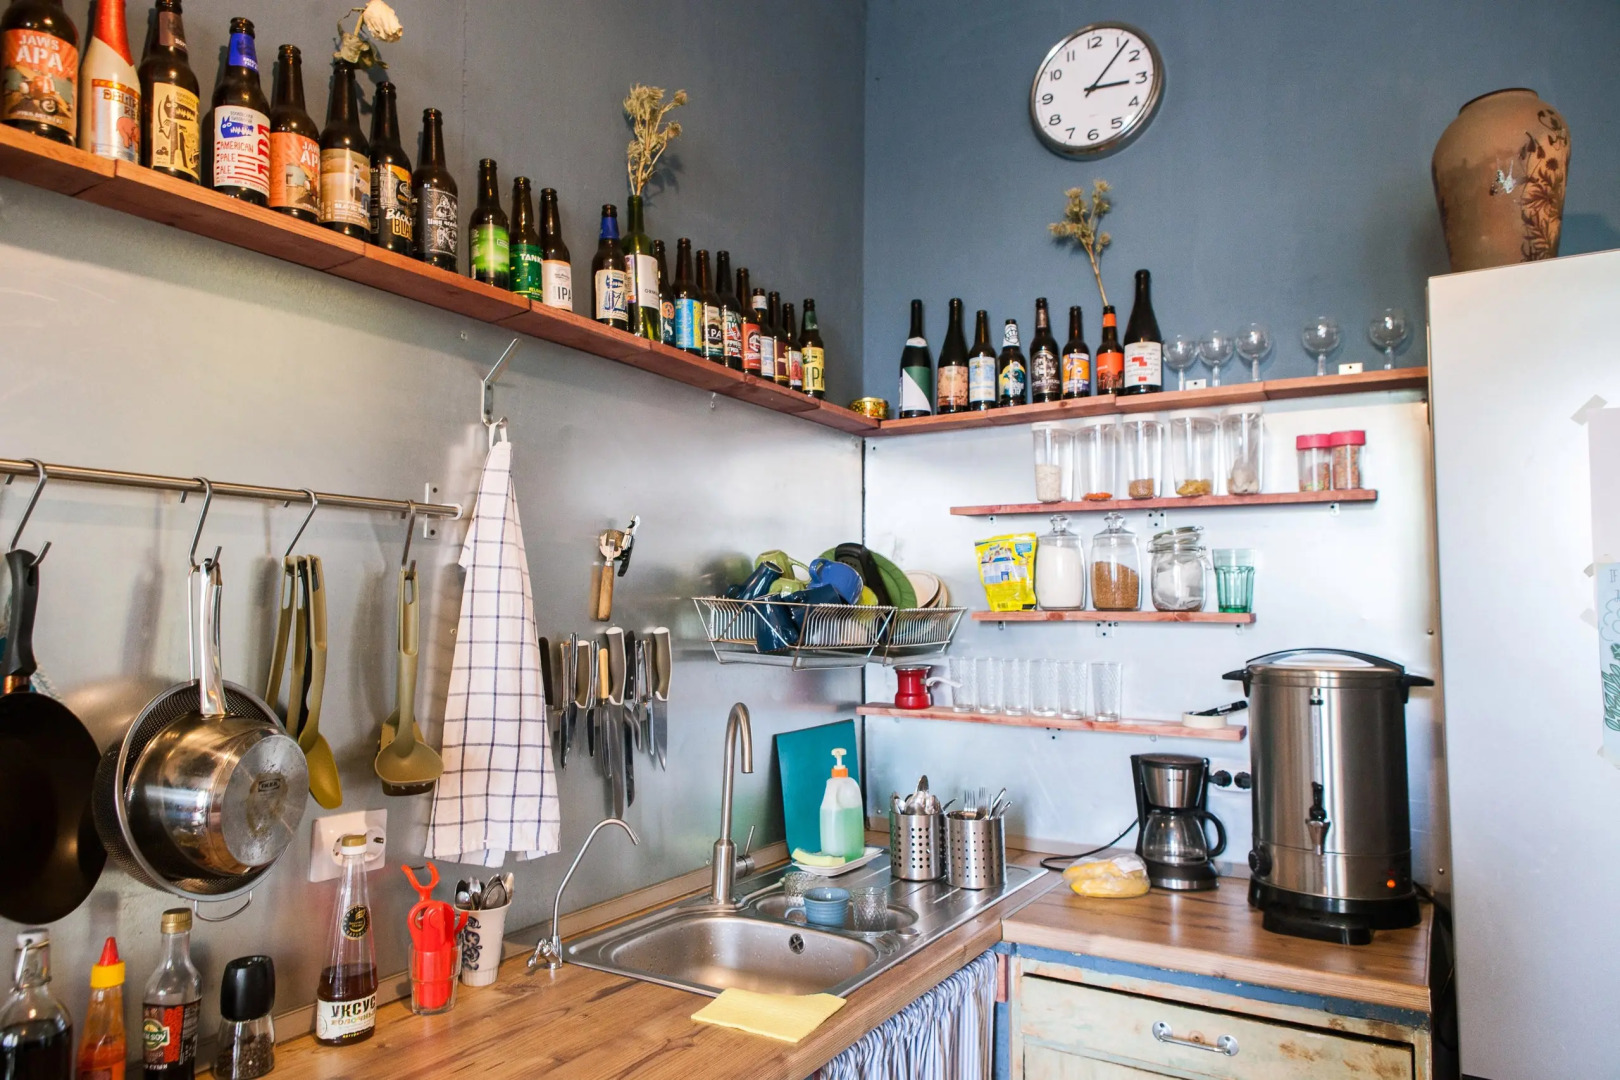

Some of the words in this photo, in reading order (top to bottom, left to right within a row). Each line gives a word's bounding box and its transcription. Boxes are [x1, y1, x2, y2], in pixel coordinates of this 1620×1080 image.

[19, 34, 60, 51] JAWS
[1087, 36, 1102, 49] 12
[15, 45, 63, 72] APA
[1066, 50, 1075, 62] 11
[1128, 50, 1140, 62] 2
[1050, 69, 1062, 81] 10
[1135, 71, 1148, 84] 3
[1042, 93, 1054, 105] 9
[1128, 95, 1139, 107] 4
[1049, 114, 1061, 126] 8
[1111, 117, 1123, 129] 5
[1065, 127, 1077, 140] 7
[1087, 129, 1099, 140] 6
[220, 141, 254, 153] AMERICAN
[220, 153, 236, 162] PALE
[220, 165, 231, 174] ALE
